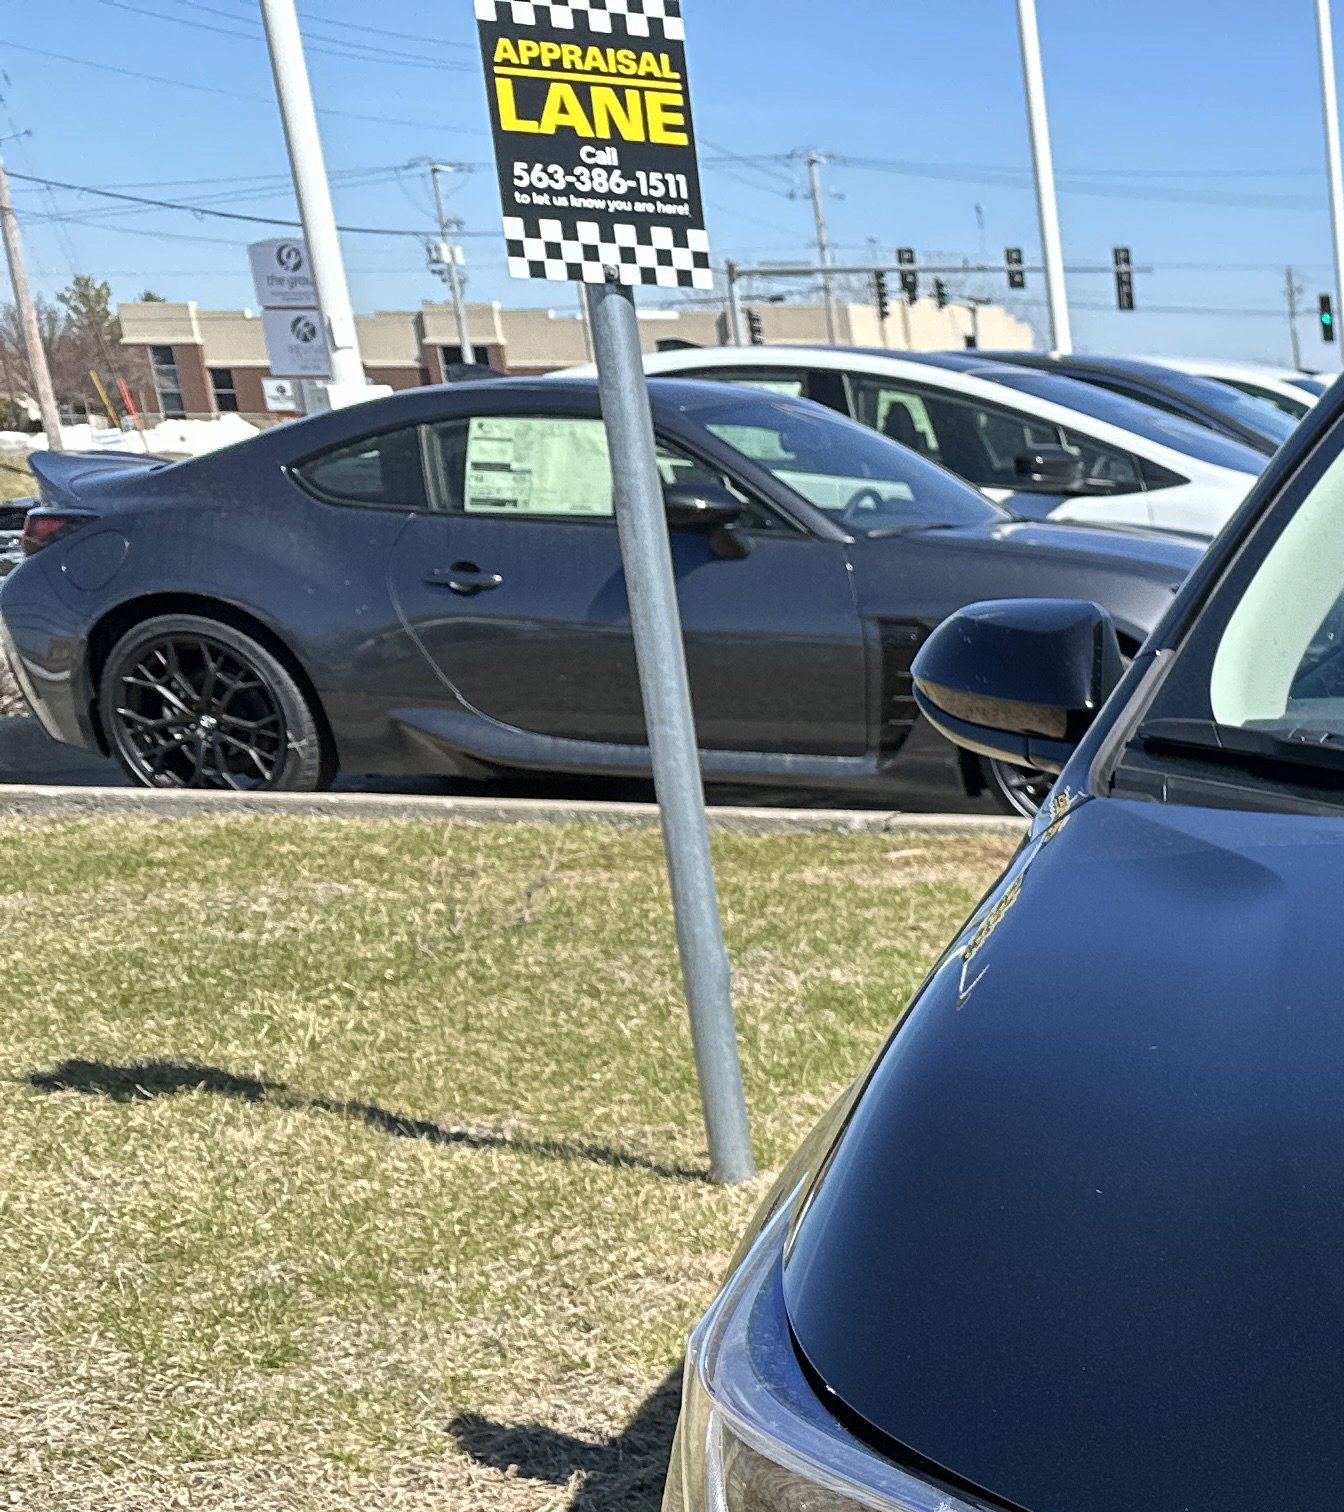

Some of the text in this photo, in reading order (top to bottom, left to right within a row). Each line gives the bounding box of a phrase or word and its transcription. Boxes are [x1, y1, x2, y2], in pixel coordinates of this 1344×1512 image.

[493, 37, 681, 79] APPRAISAL
[494, 77, 689, 146] LANE
[579, 145, 619, 166] Call
[513, 161, 688, 200] 563-386-1511
[514, 191, 530, 204] to
[532, 192, 551, 206] let
[553, 195, 569, 207] us
[570, 194, 606, 209] know
[607, 199, 632, 213] you
[633, 202, 655, 213] are
